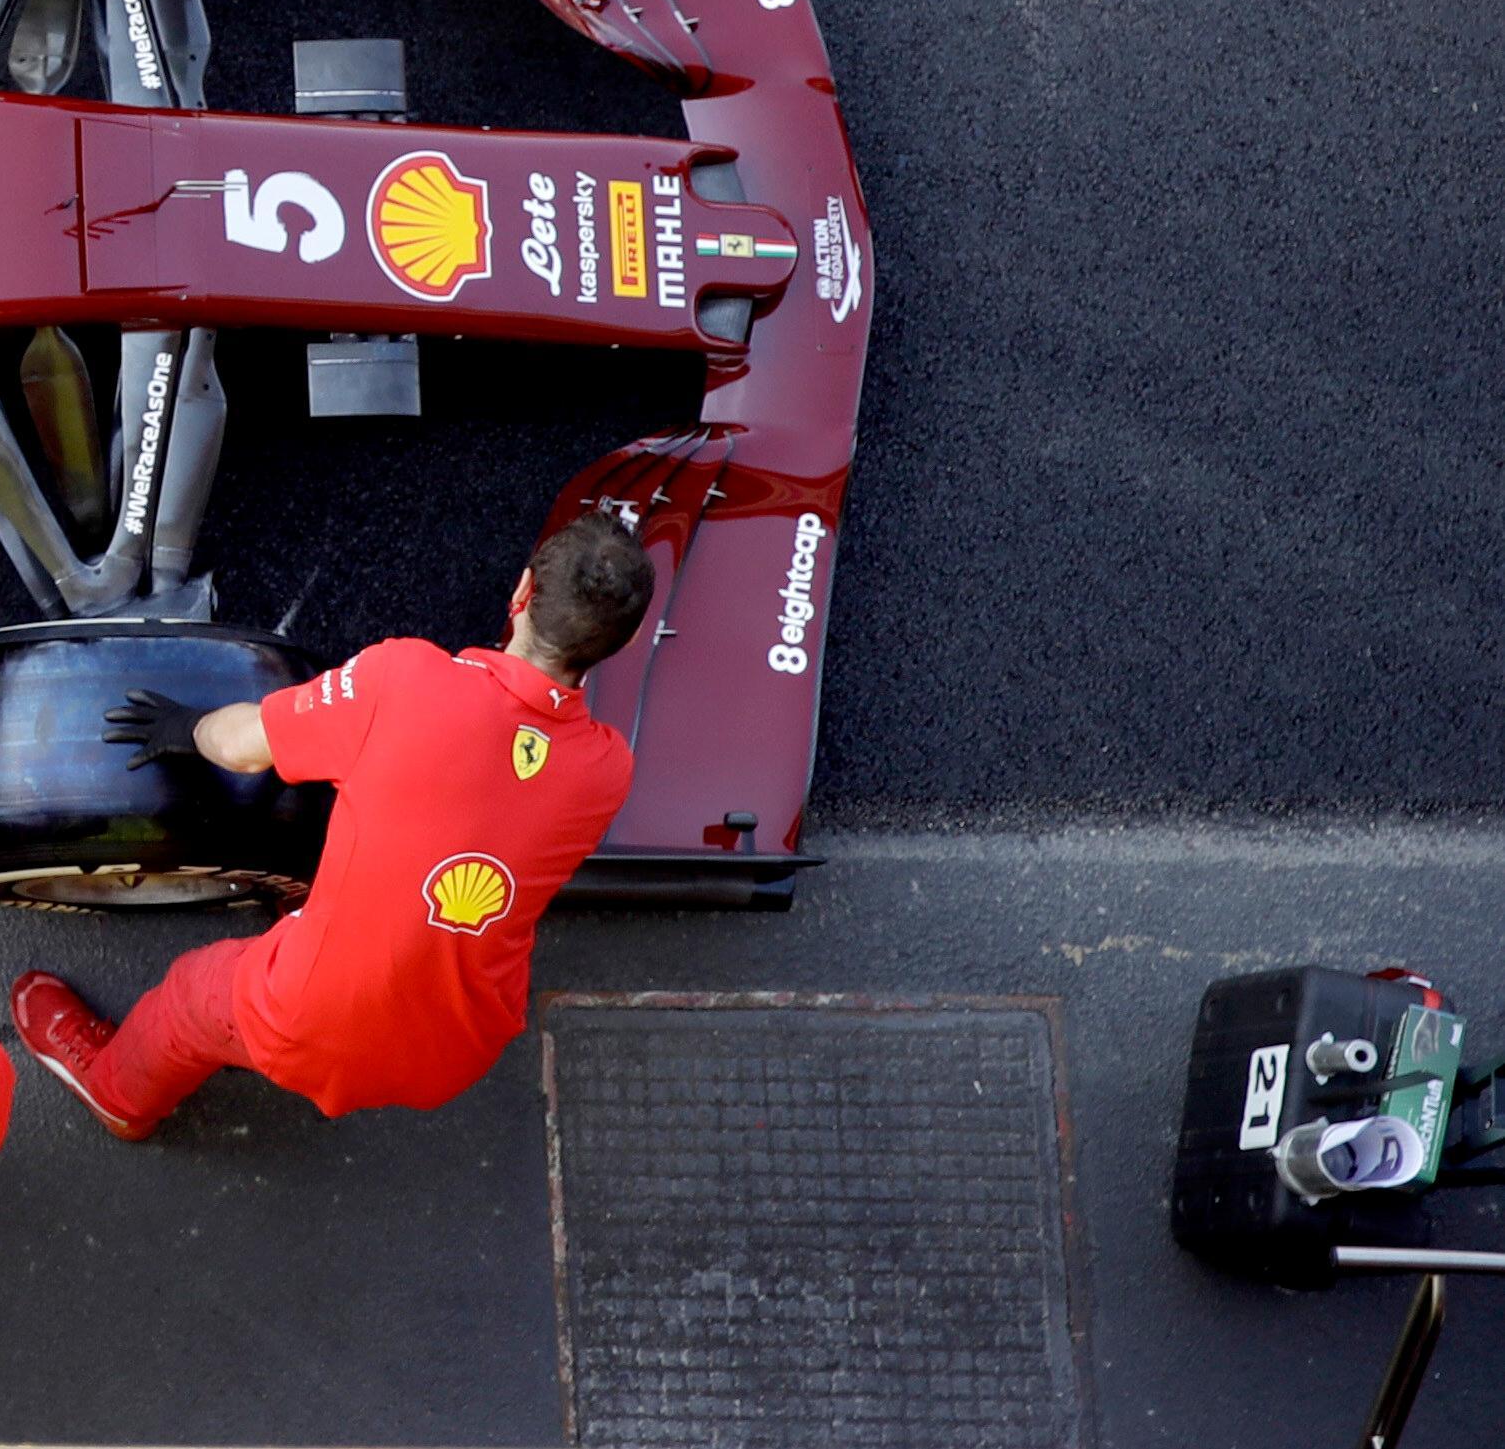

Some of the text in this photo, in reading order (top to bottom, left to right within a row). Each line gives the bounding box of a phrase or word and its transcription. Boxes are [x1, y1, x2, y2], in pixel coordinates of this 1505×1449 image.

[222, 168, 347, 264] 5
[520, 171, 563, 297] Lete
[571, 170, 601, 304] kaspersky
[616, 191, 640, 287] PIRELLI
[652, 174, 687, 309] MAHLE
[813, 218, 831, 276] ACTION
[827, 195, 843, 244] SAFETY
[124, 352, 173, 536] #WeRaceAsOne
[339, 655, 360, 700] LOT
[1248, 1053, 1278, 1130] 21
